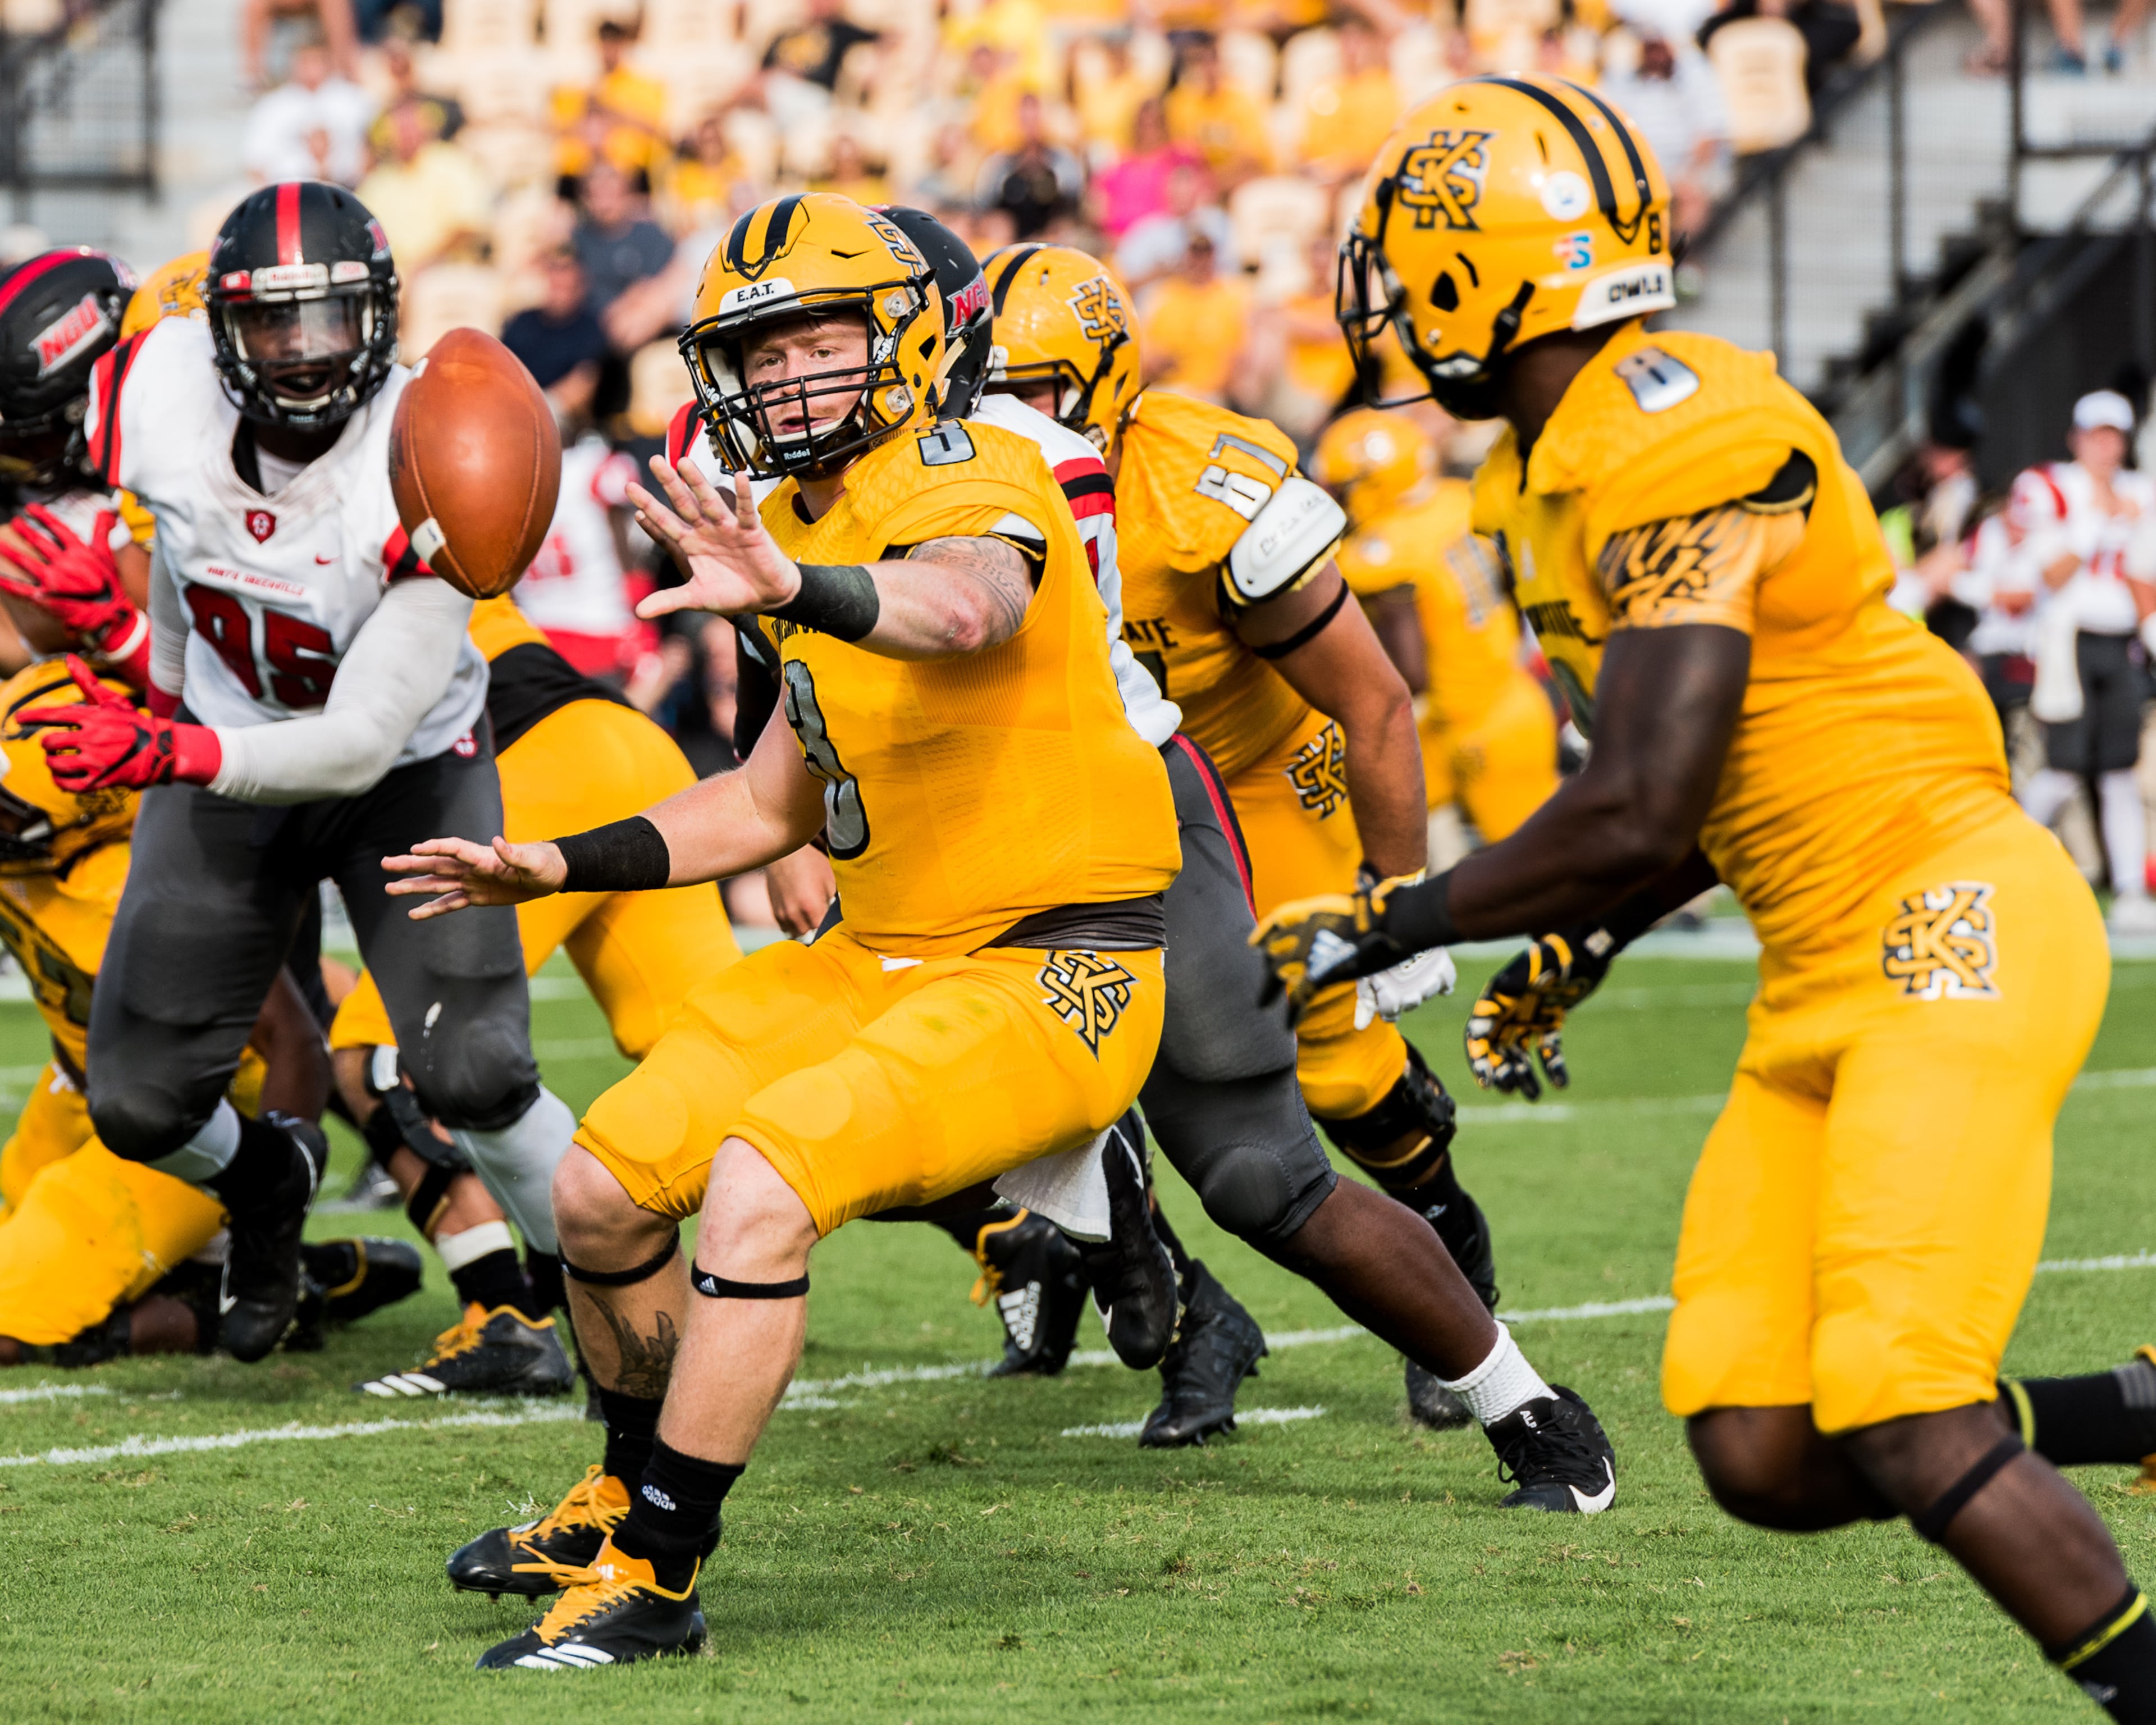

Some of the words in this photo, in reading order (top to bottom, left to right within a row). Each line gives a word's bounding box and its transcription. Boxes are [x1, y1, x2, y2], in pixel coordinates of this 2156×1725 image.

[737, 282, 774, 302] E.A.T.
[40, 295, 101, 368] NGU
[783, 448, 811, 460] Riddel
[1118, 617, 1180, 648] ATE
[1014, 1280, 1042, 1350] adidas
[1519, 1409, 1542, 1435] ALP
